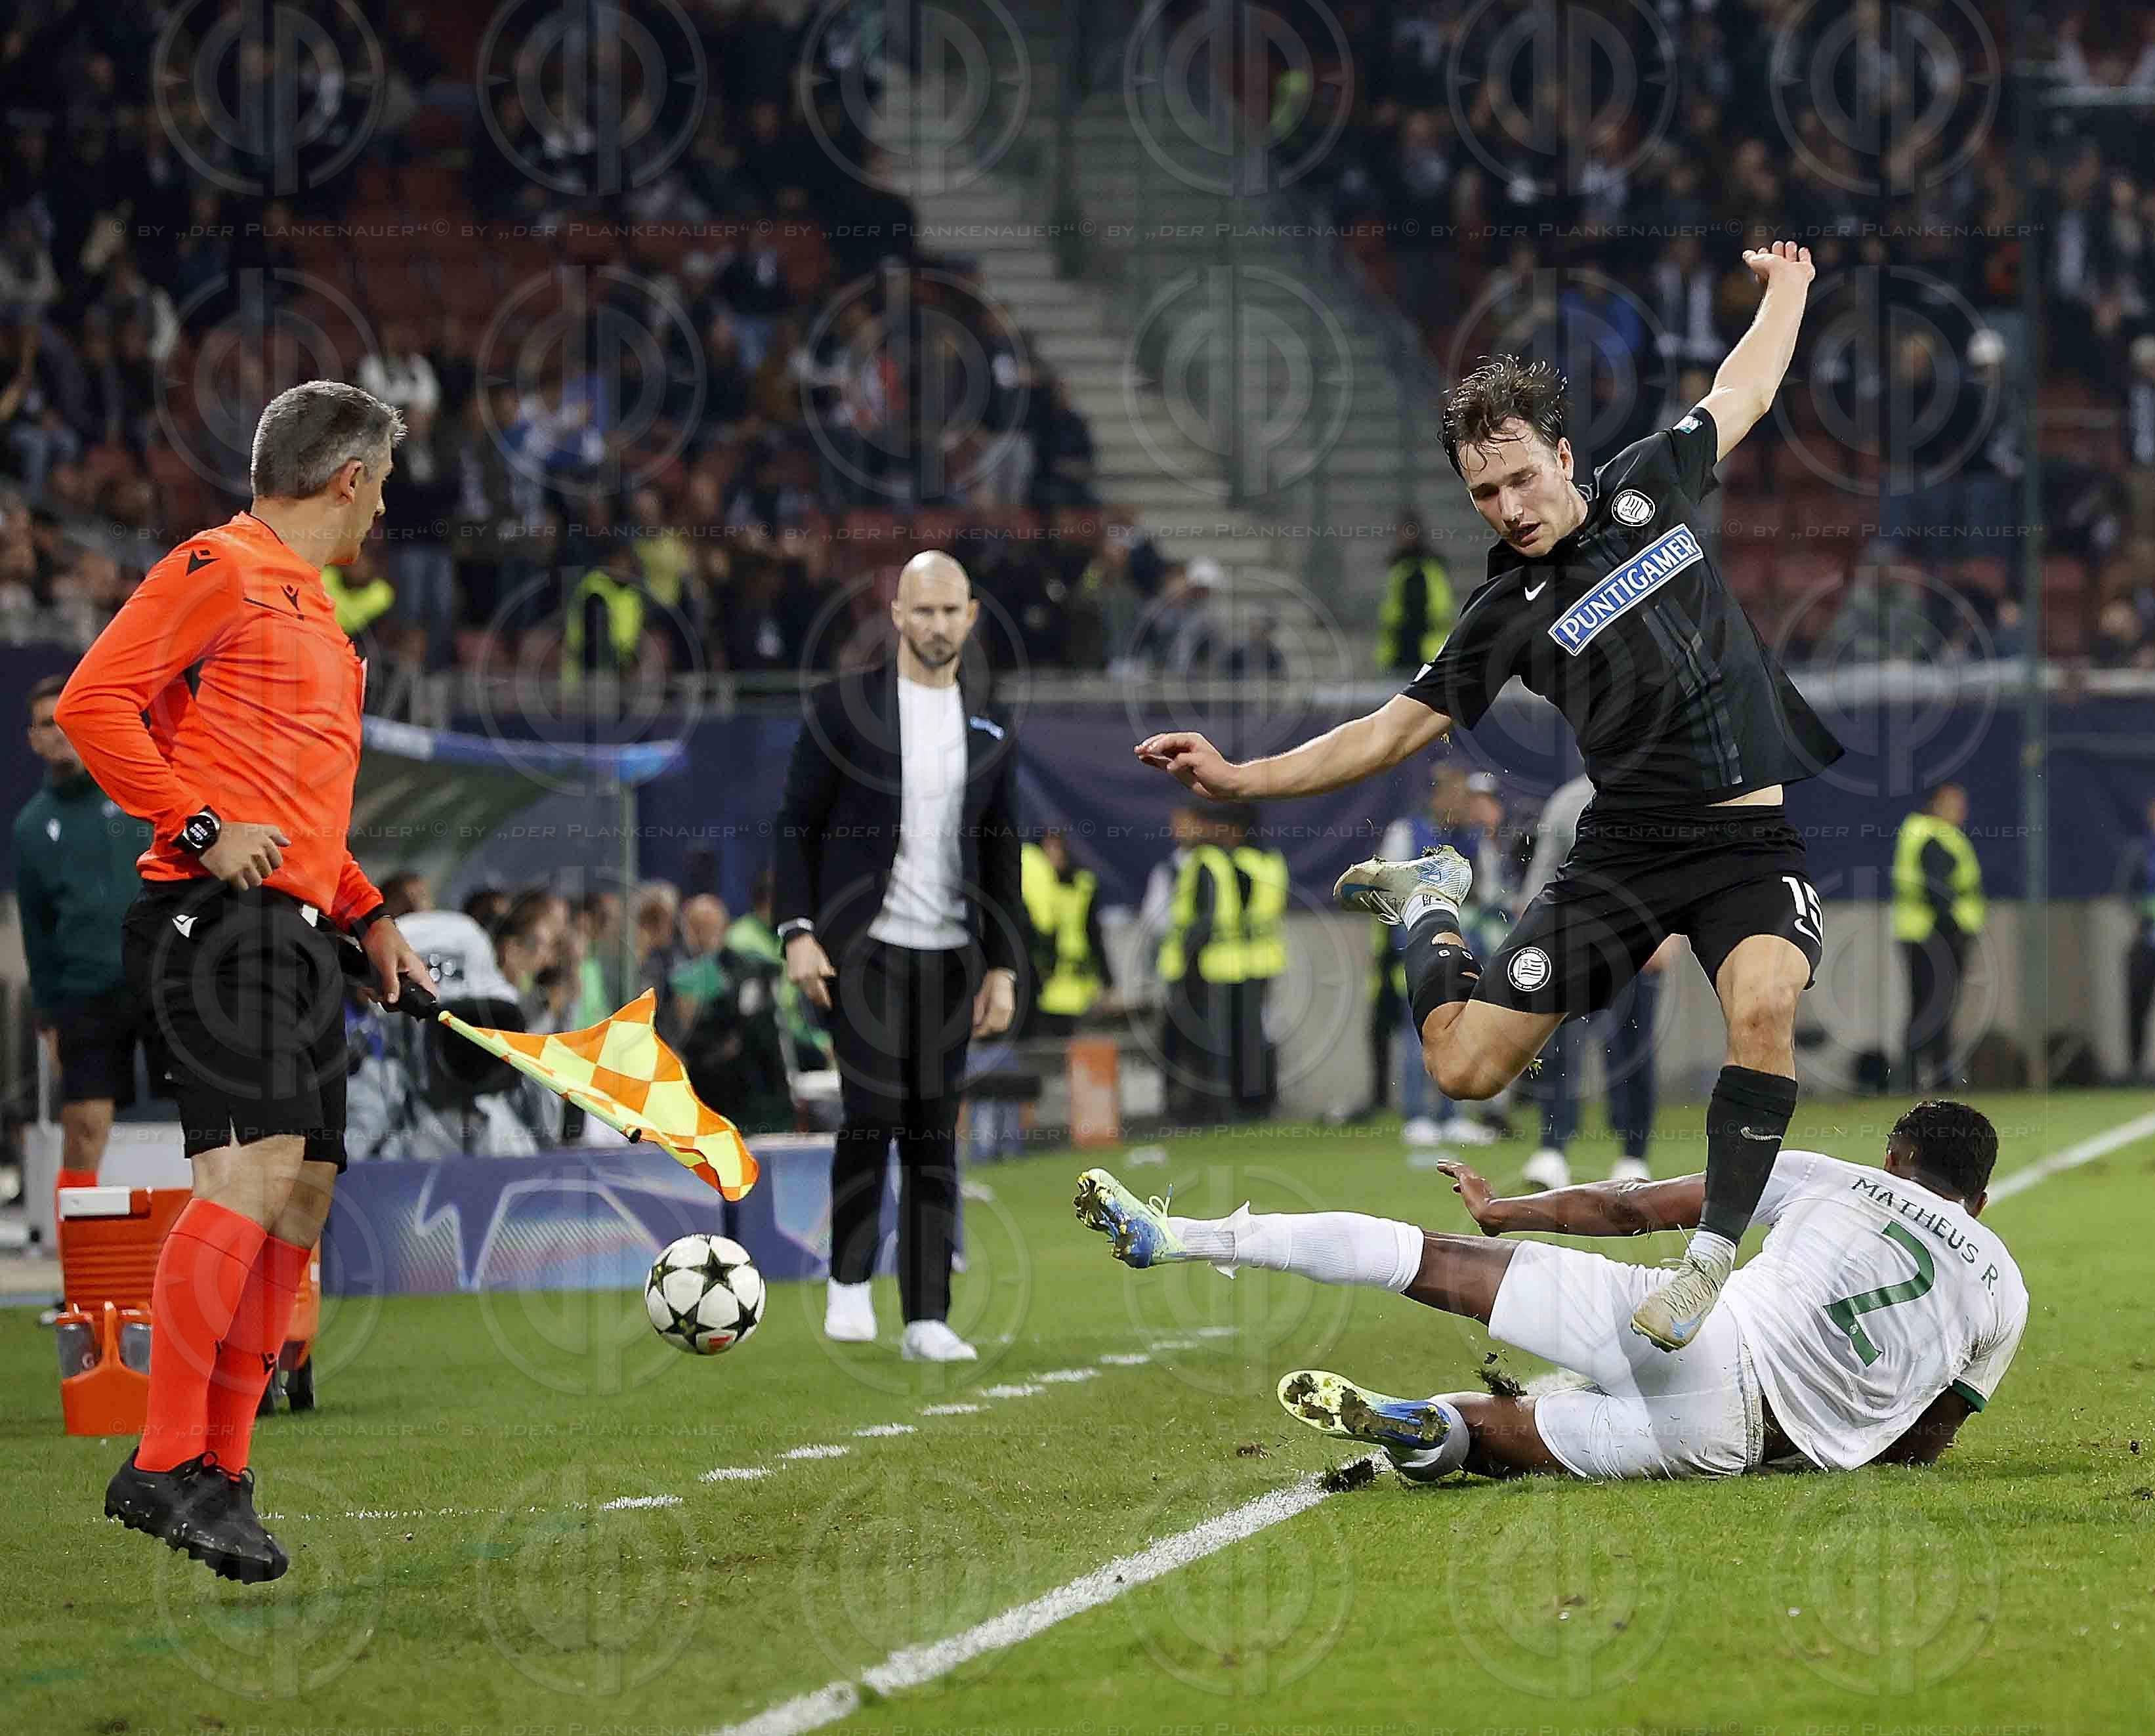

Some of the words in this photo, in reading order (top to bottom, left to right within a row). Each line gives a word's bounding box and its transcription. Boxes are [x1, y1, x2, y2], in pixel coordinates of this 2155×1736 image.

[1560, 534, 1697, 644] PUNTIGAMER
[1822, 1220, 1935, 1367] 2
[1851, 1177, 1979, 1264] MATHEUS
[1980, 1263, 1999, 1296] R.
